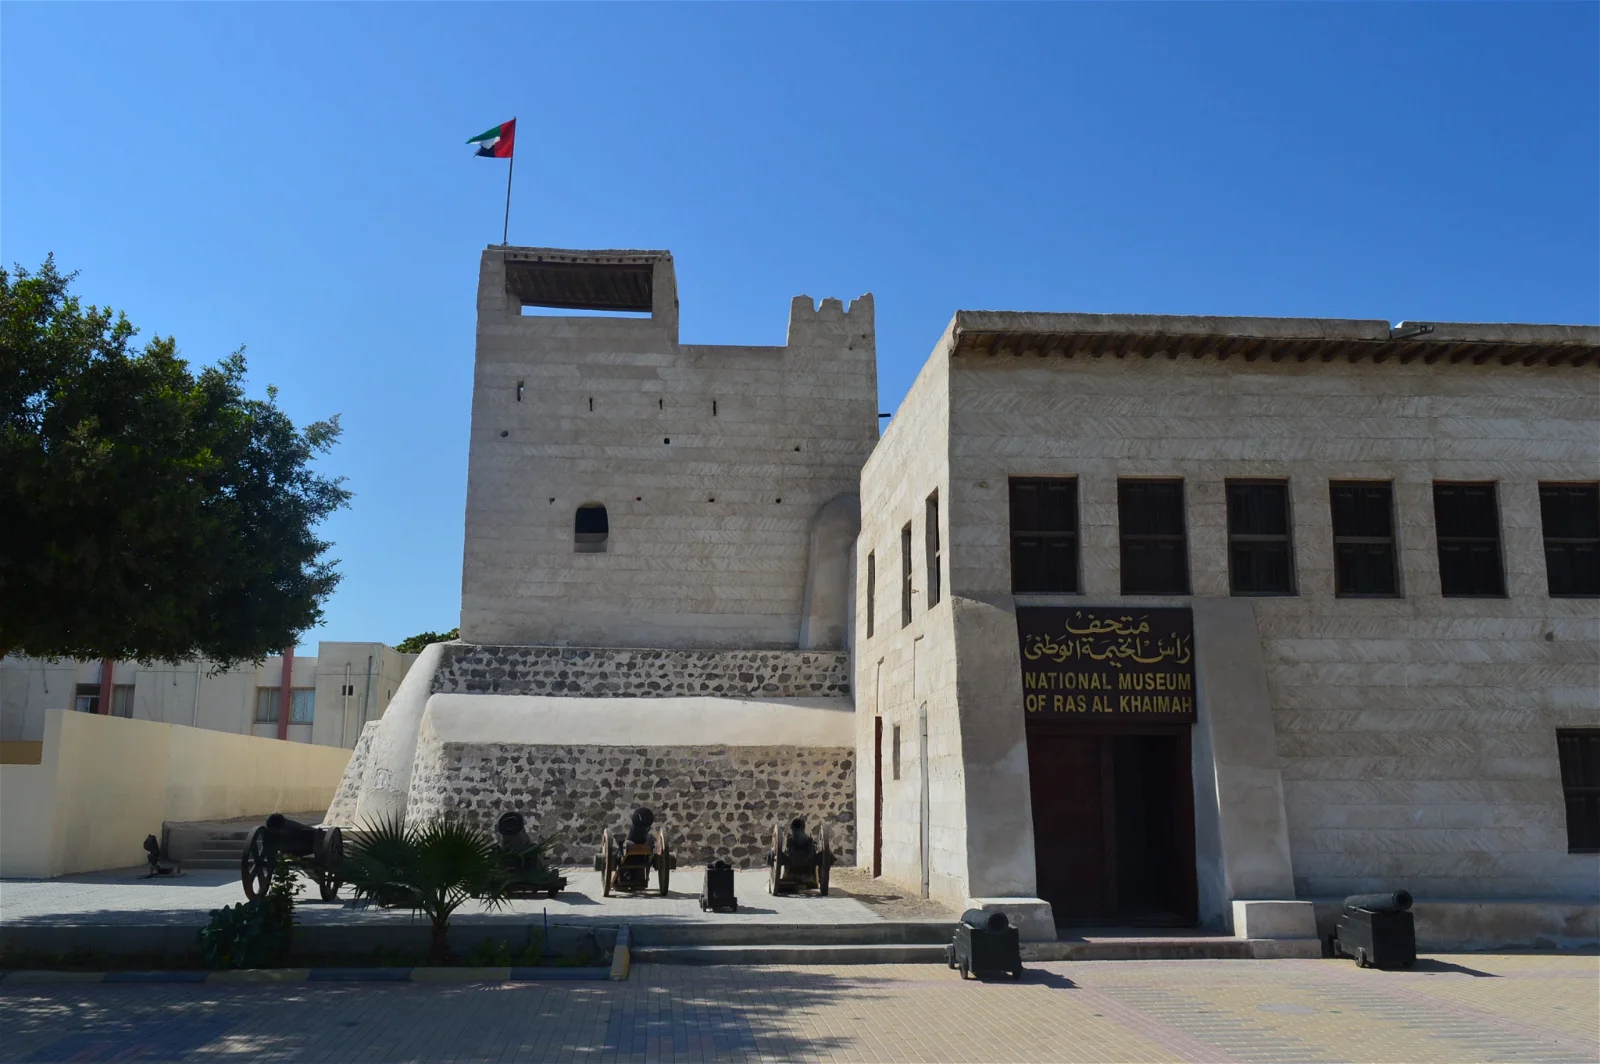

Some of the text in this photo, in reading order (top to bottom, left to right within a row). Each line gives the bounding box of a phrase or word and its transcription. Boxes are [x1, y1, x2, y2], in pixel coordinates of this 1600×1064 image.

[1025, 672, 1191, 691] NATIONAL MUSEUM
[1026, 694, 1192, 713] OF RAS AL KHAIMAH
